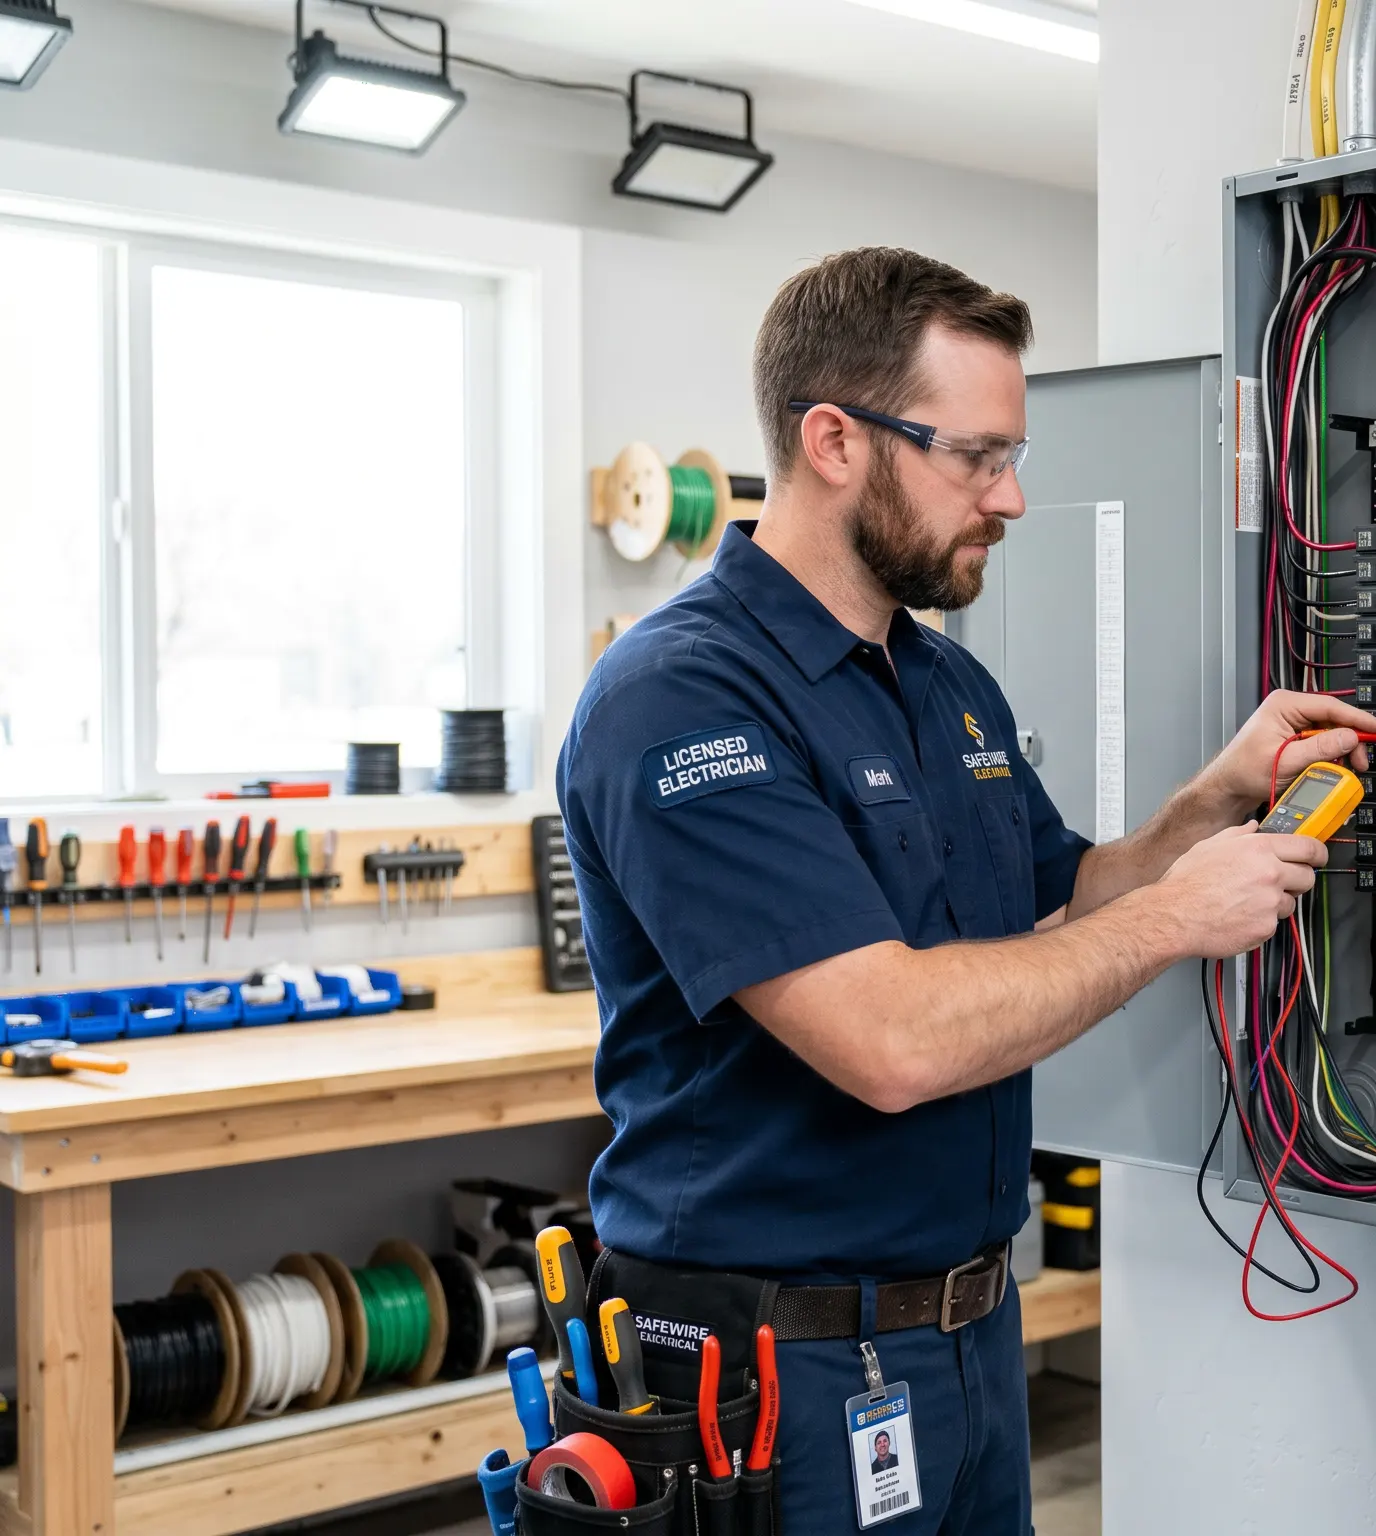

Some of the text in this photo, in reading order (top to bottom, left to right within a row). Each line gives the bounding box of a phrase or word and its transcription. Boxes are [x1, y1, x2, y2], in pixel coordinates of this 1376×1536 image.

[663, 735, 748, 772] LICENSED
[657, 754, 767, 797] ELECTRICIAN
[635, 1315, 709, 1341] SAFEWIRE
